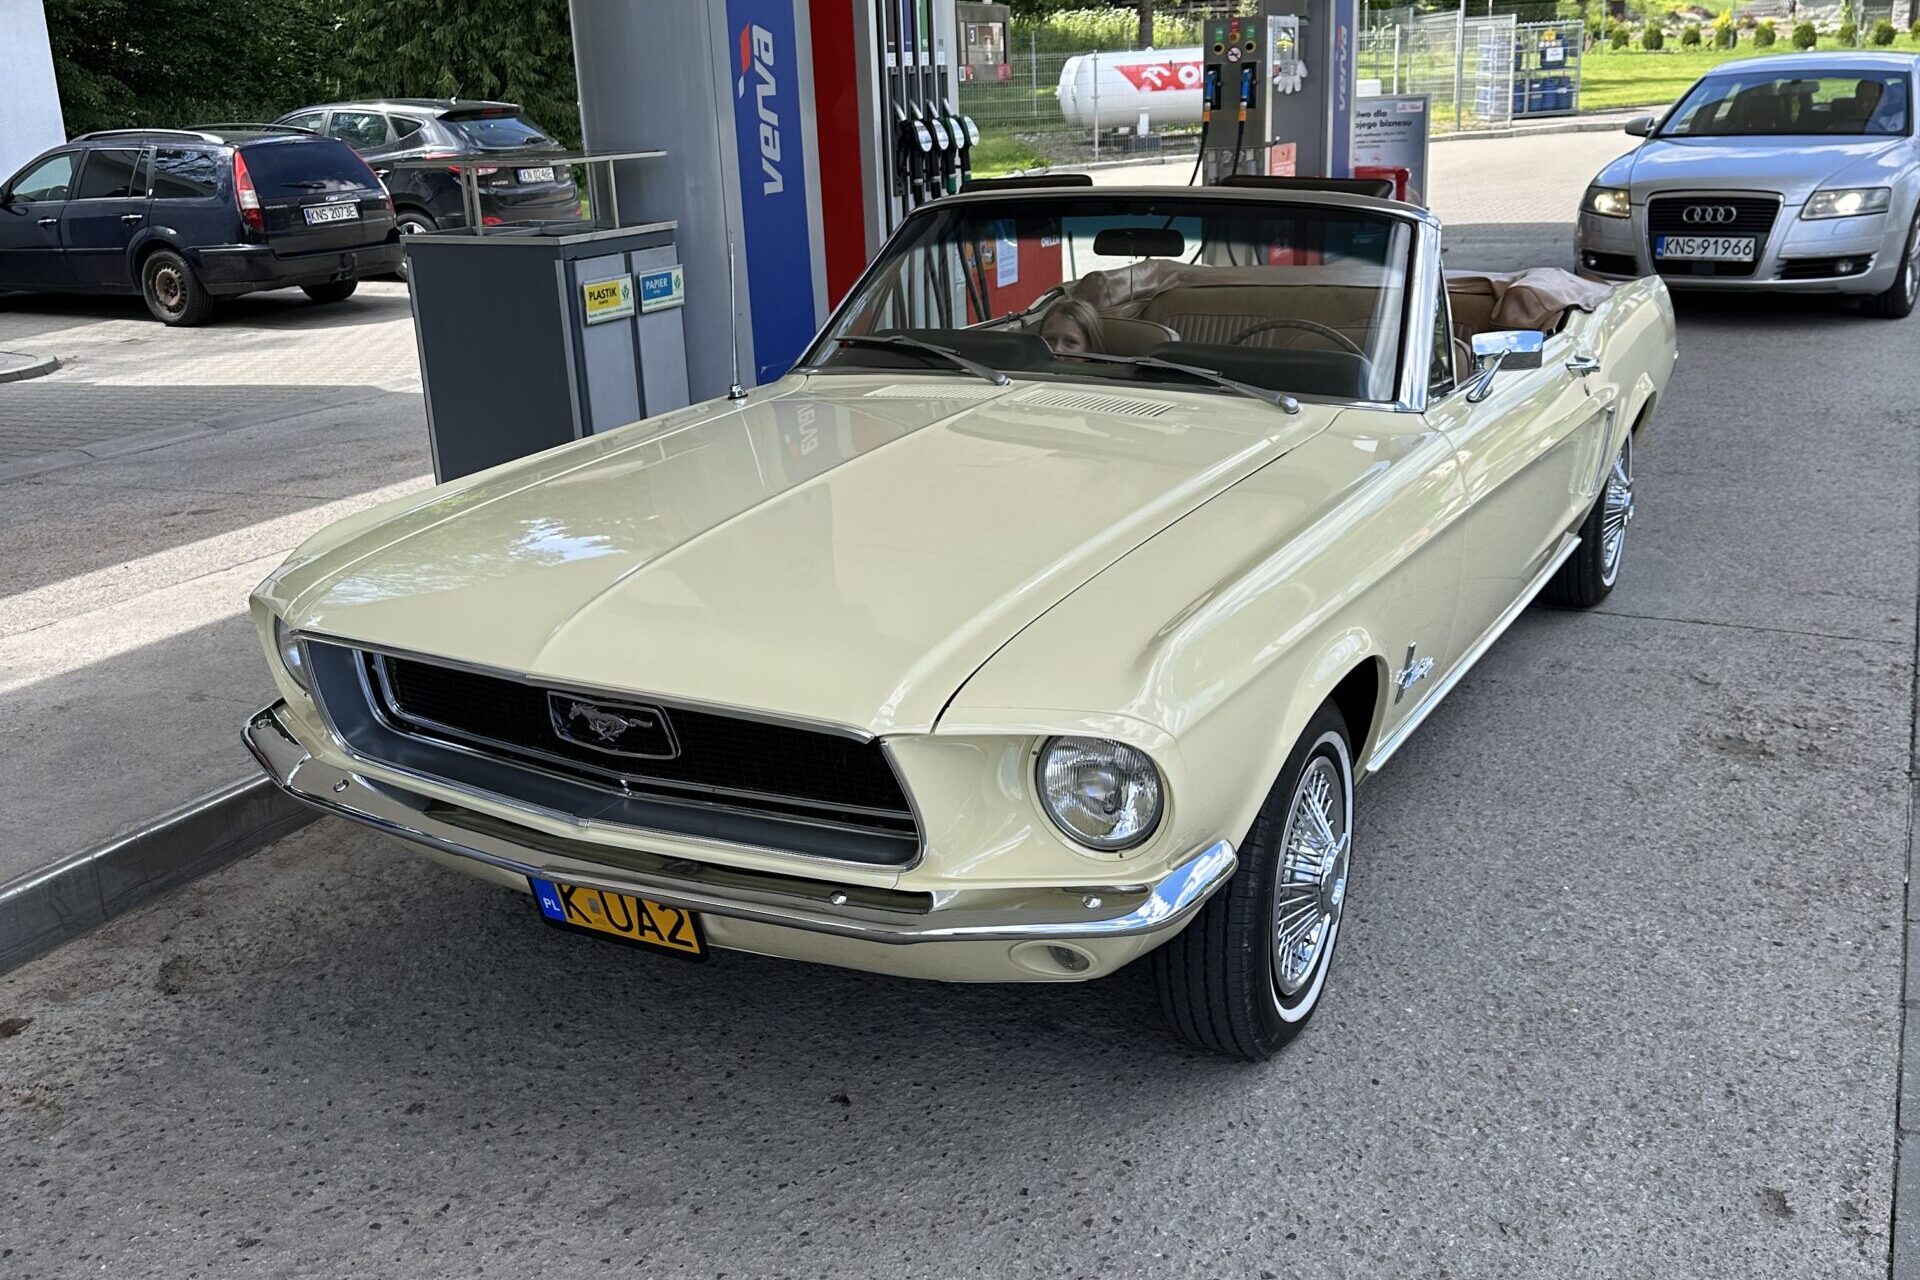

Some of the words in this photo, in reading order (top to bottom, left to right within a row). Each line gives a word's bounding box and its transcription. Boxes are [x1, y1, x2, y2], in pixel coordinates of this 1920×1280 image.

[969, 29, 975, 42] 3
[752, 24, 784, 196] verva
[1373, 109, 1388, 118] dla
[1379, 120, 1412, 128] biznesu
[310, 208, 329, 221] KNS
[330, 205, 357, 219] 2073E
[1664, 238, 1696, 255] KNS
[1700, 238, 1753, 256] 91966
[645, 277, 669, 290] PAPIER
[588, 286, 617, 301] PLASTIK
[542, 897, 561, 912] PL
[557, 883, 592, 924] K
